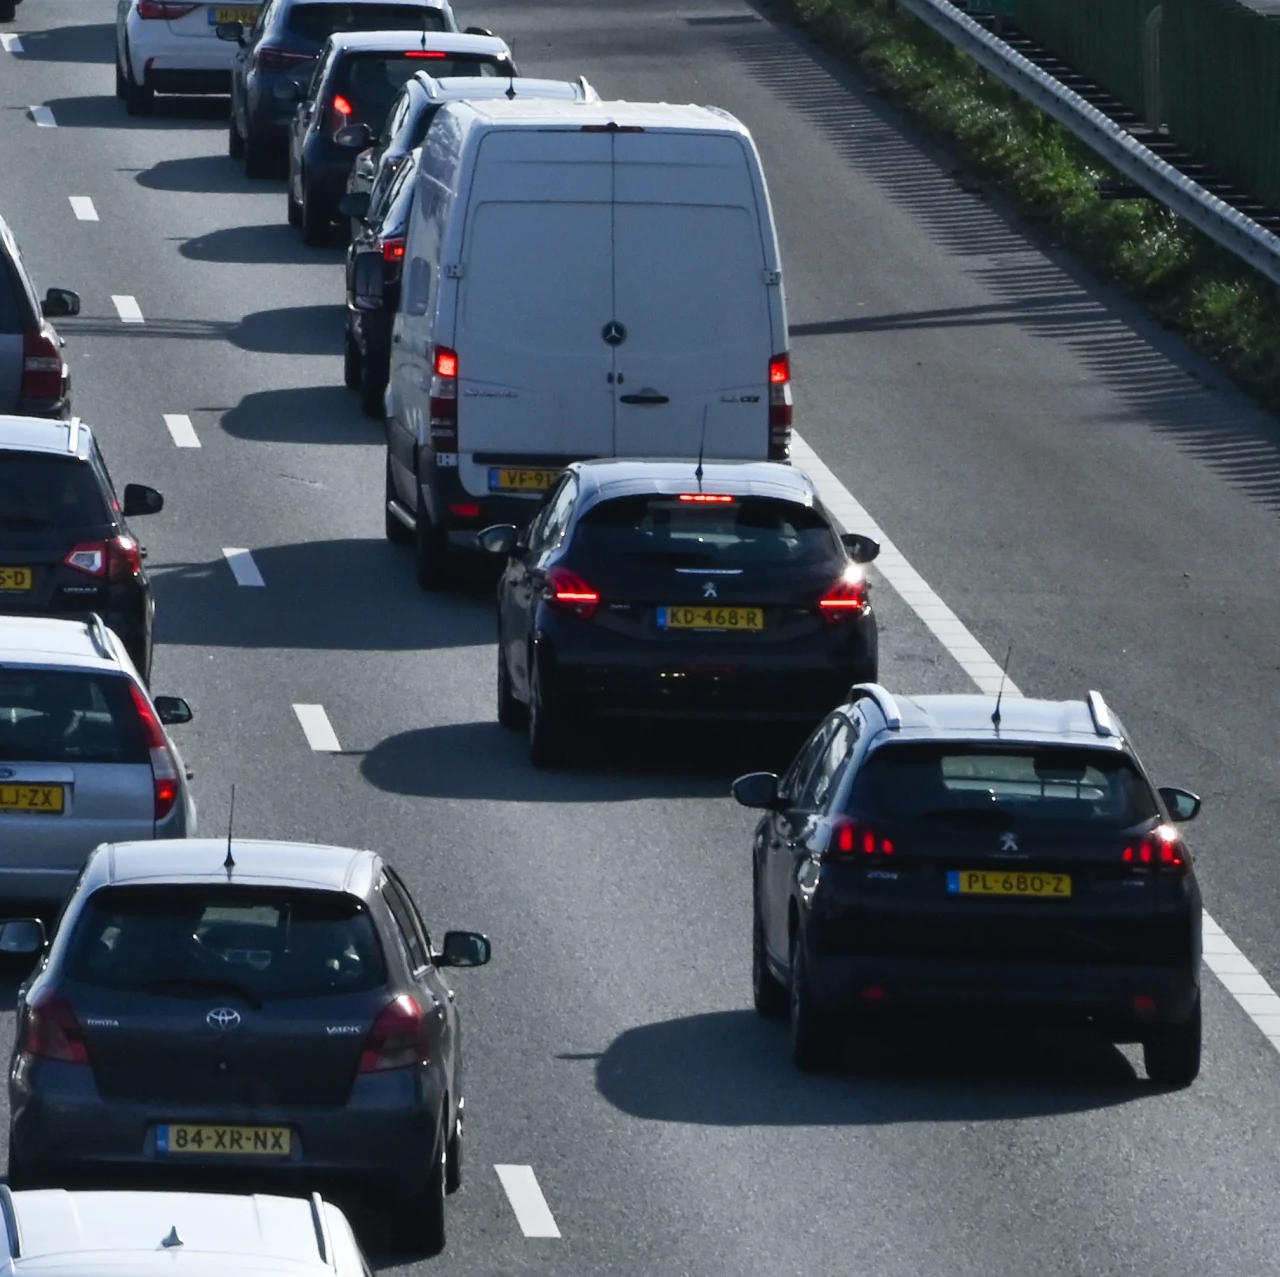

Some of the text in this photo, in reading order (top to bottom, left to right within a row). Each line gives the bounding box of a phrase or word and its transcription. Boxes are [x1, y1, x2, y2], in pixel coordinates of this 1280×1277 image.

[669, 609, 759, 627] KD-468-R
[967, 875, 1065, 894] PL-680-Z
[174, 1128, 286, 1151] 84-XR-NX
